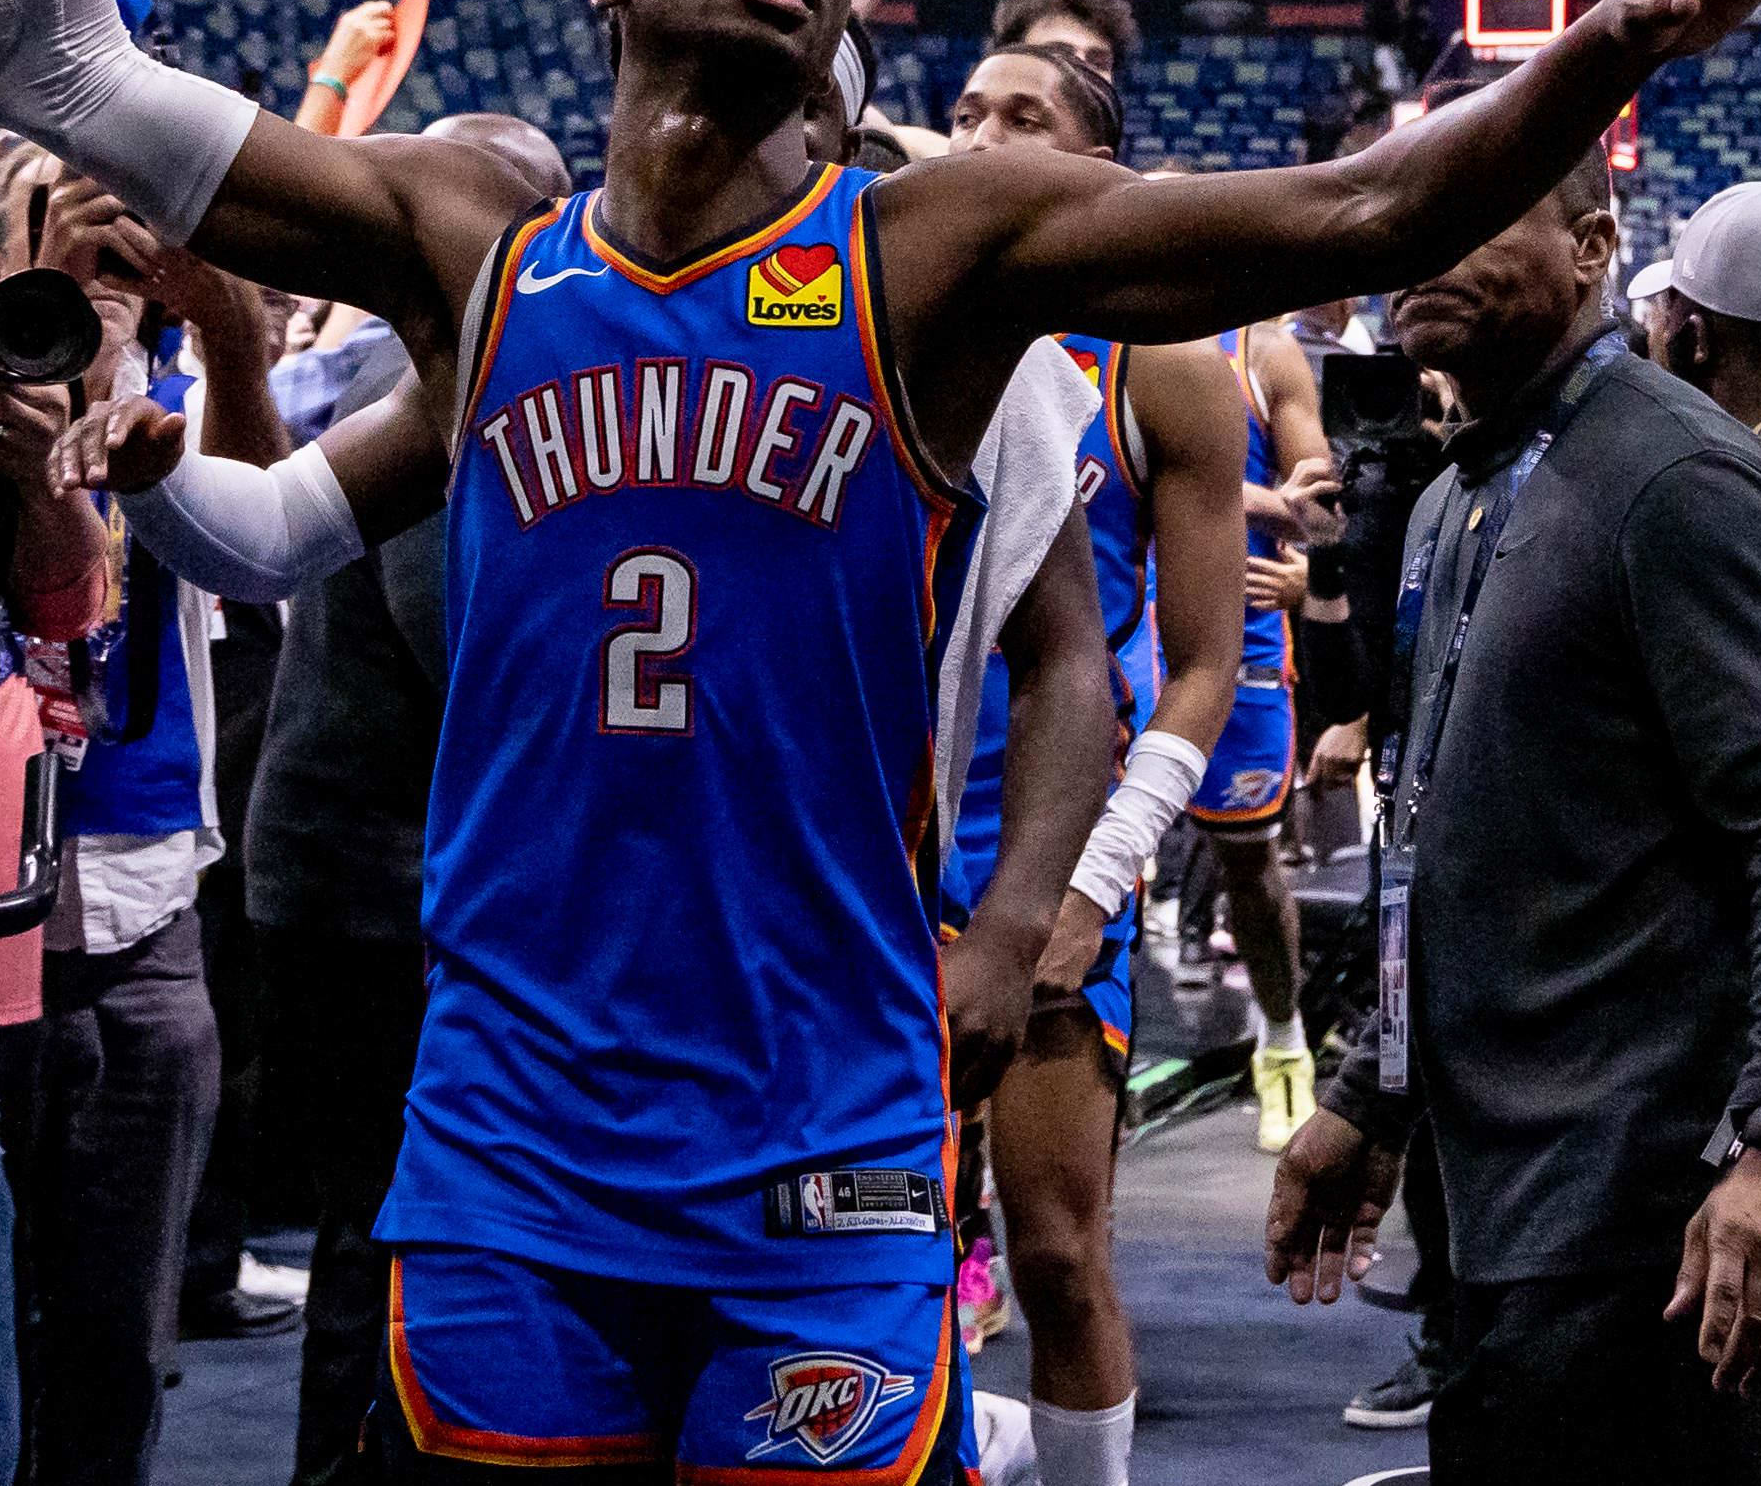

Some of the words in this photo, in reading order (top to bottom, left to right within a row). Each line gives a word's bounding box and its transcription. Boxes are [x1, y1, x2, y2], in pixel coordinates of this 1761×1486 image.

[481, 359, 881, 532] THUNDER
[599, 546, 699, 736] 2
[774, 1375, 860, 1434] OKC
